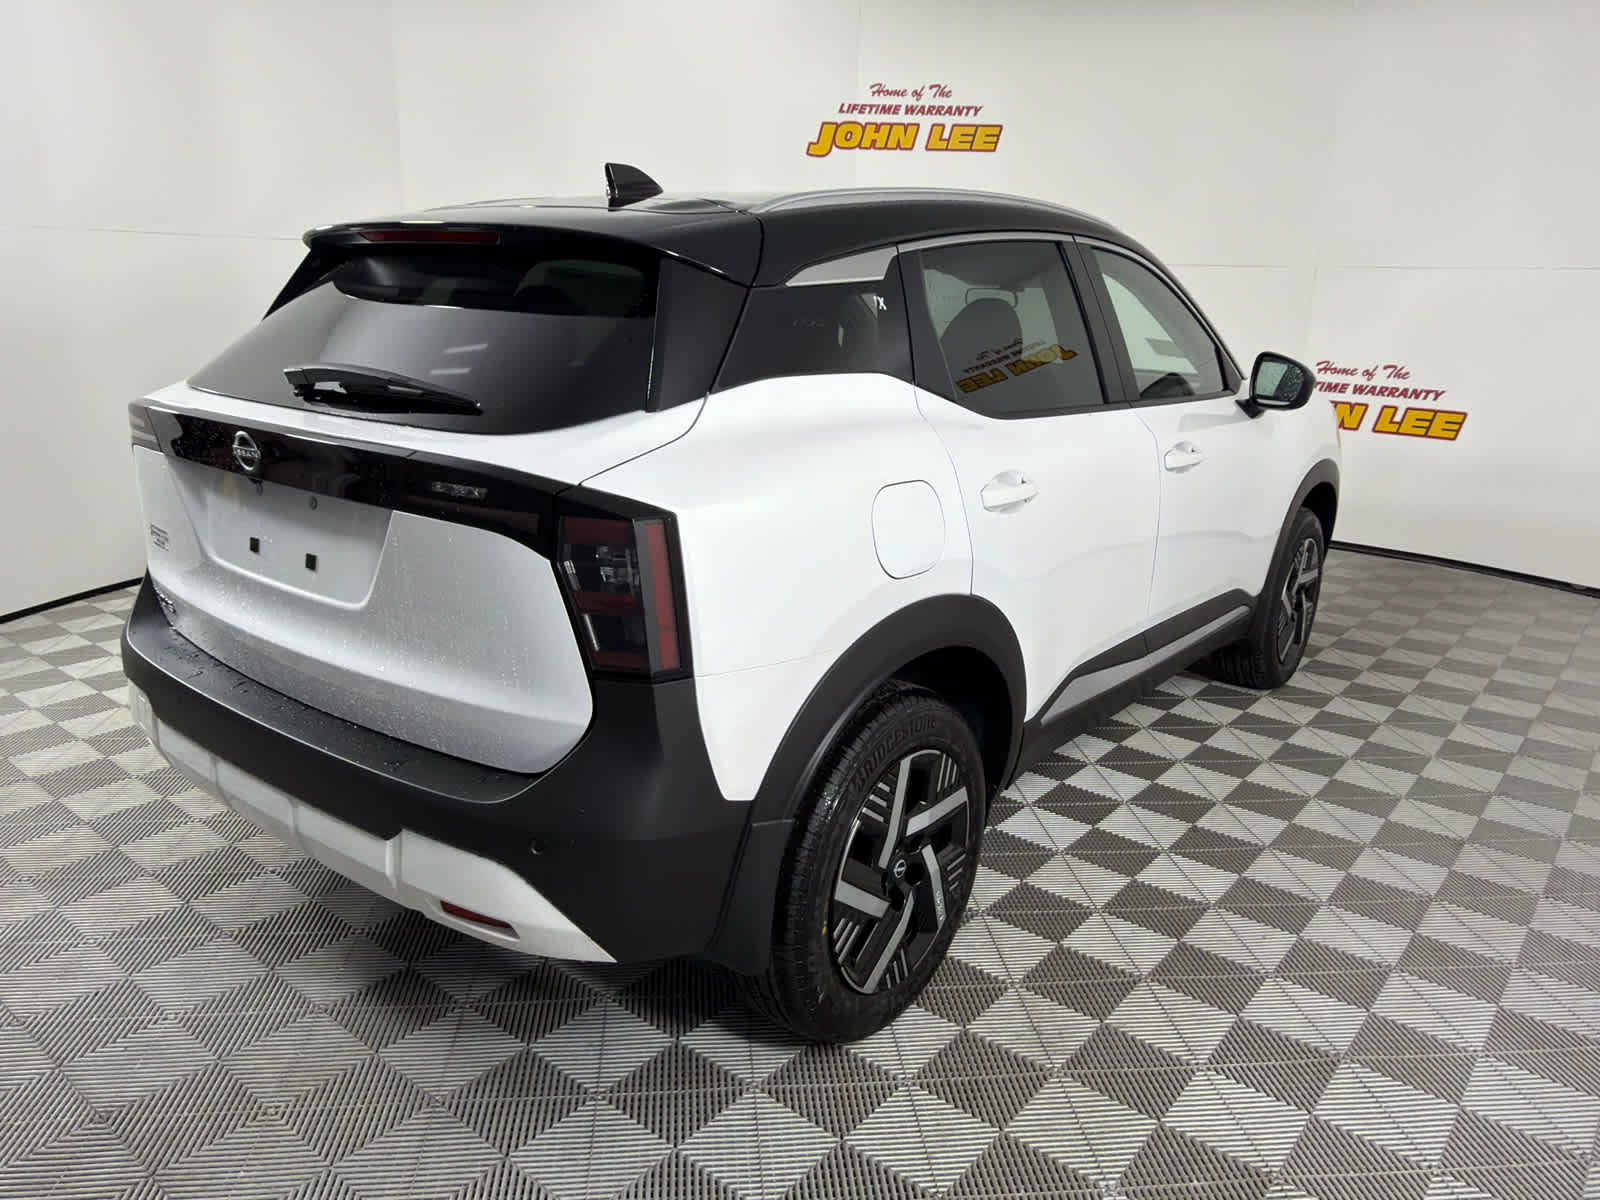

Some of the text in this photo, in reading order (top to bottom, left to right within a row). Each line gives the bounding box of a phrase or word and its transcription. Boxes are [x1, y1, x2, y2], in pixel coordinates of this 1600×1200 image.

[869, 82, 953, 101] Home of The
[838, 103, 983, 117] LIFETIME WARRANTY
[806, 121, 1003, 158] JOHN LEE
[1315, 360, 1411, 381] Home of The
[1314, 381, 1446, 401] TIME WARRANTY
[1372, 405, 1468, 441] LEE
